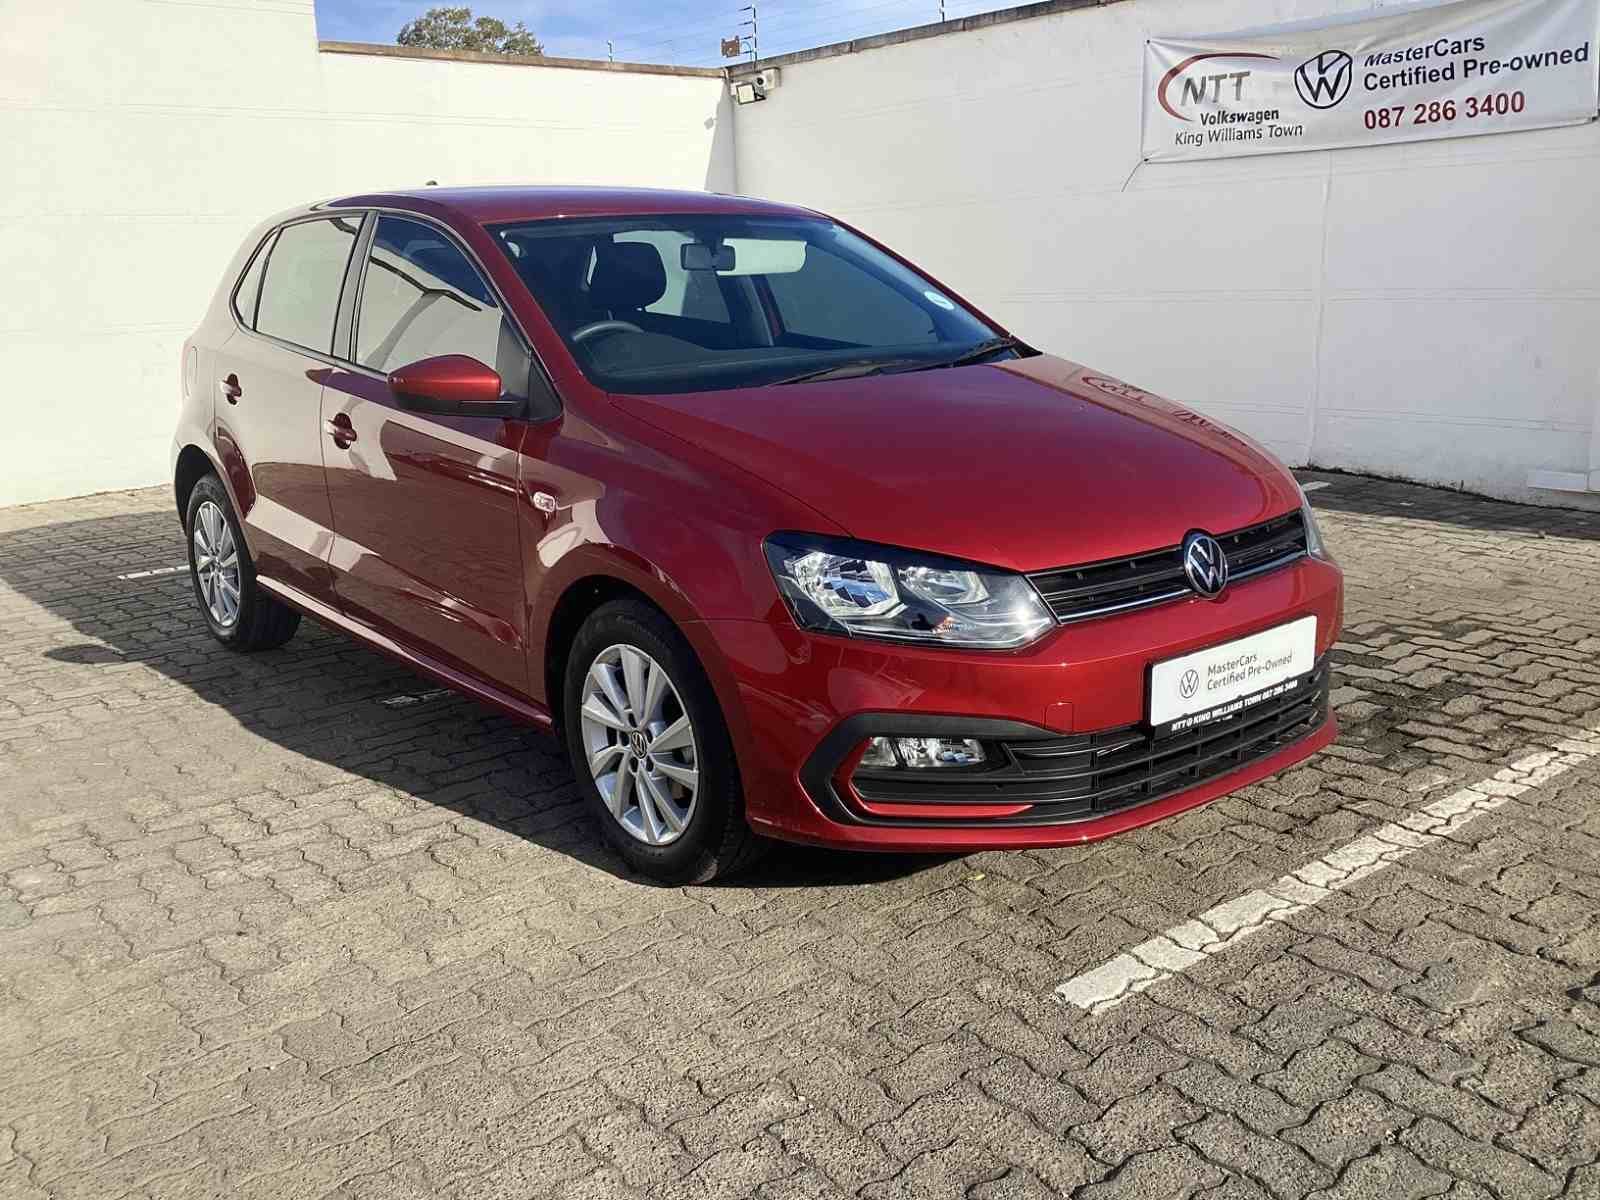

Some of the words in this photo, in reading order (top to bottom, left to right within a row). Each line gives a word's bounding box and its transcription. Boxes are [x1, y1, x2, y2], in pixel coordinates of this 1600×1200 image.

[1364, 36, 1485, 67] MasterCars
[1364, 62, 1455, 91] Certified
[1463, 41, 1589, 79] Pre-owned
[1180, 70, 1251, 106] NTT
[1200, 109, 1280, 126] Volkswagen
[1364, 106, 1405, 129] 087
[1413, 100, 1457, 124] 286
[1465, 91, 1525, 118] 3400
[1175, 131, 1203, 147] King
[1208, 127, 1262, 144] Williams
[1268, 124, 1303, 138] Town
[1207, 654, 1257, 676] MasterCars
[1207, 668, 1246, 690] Certified
